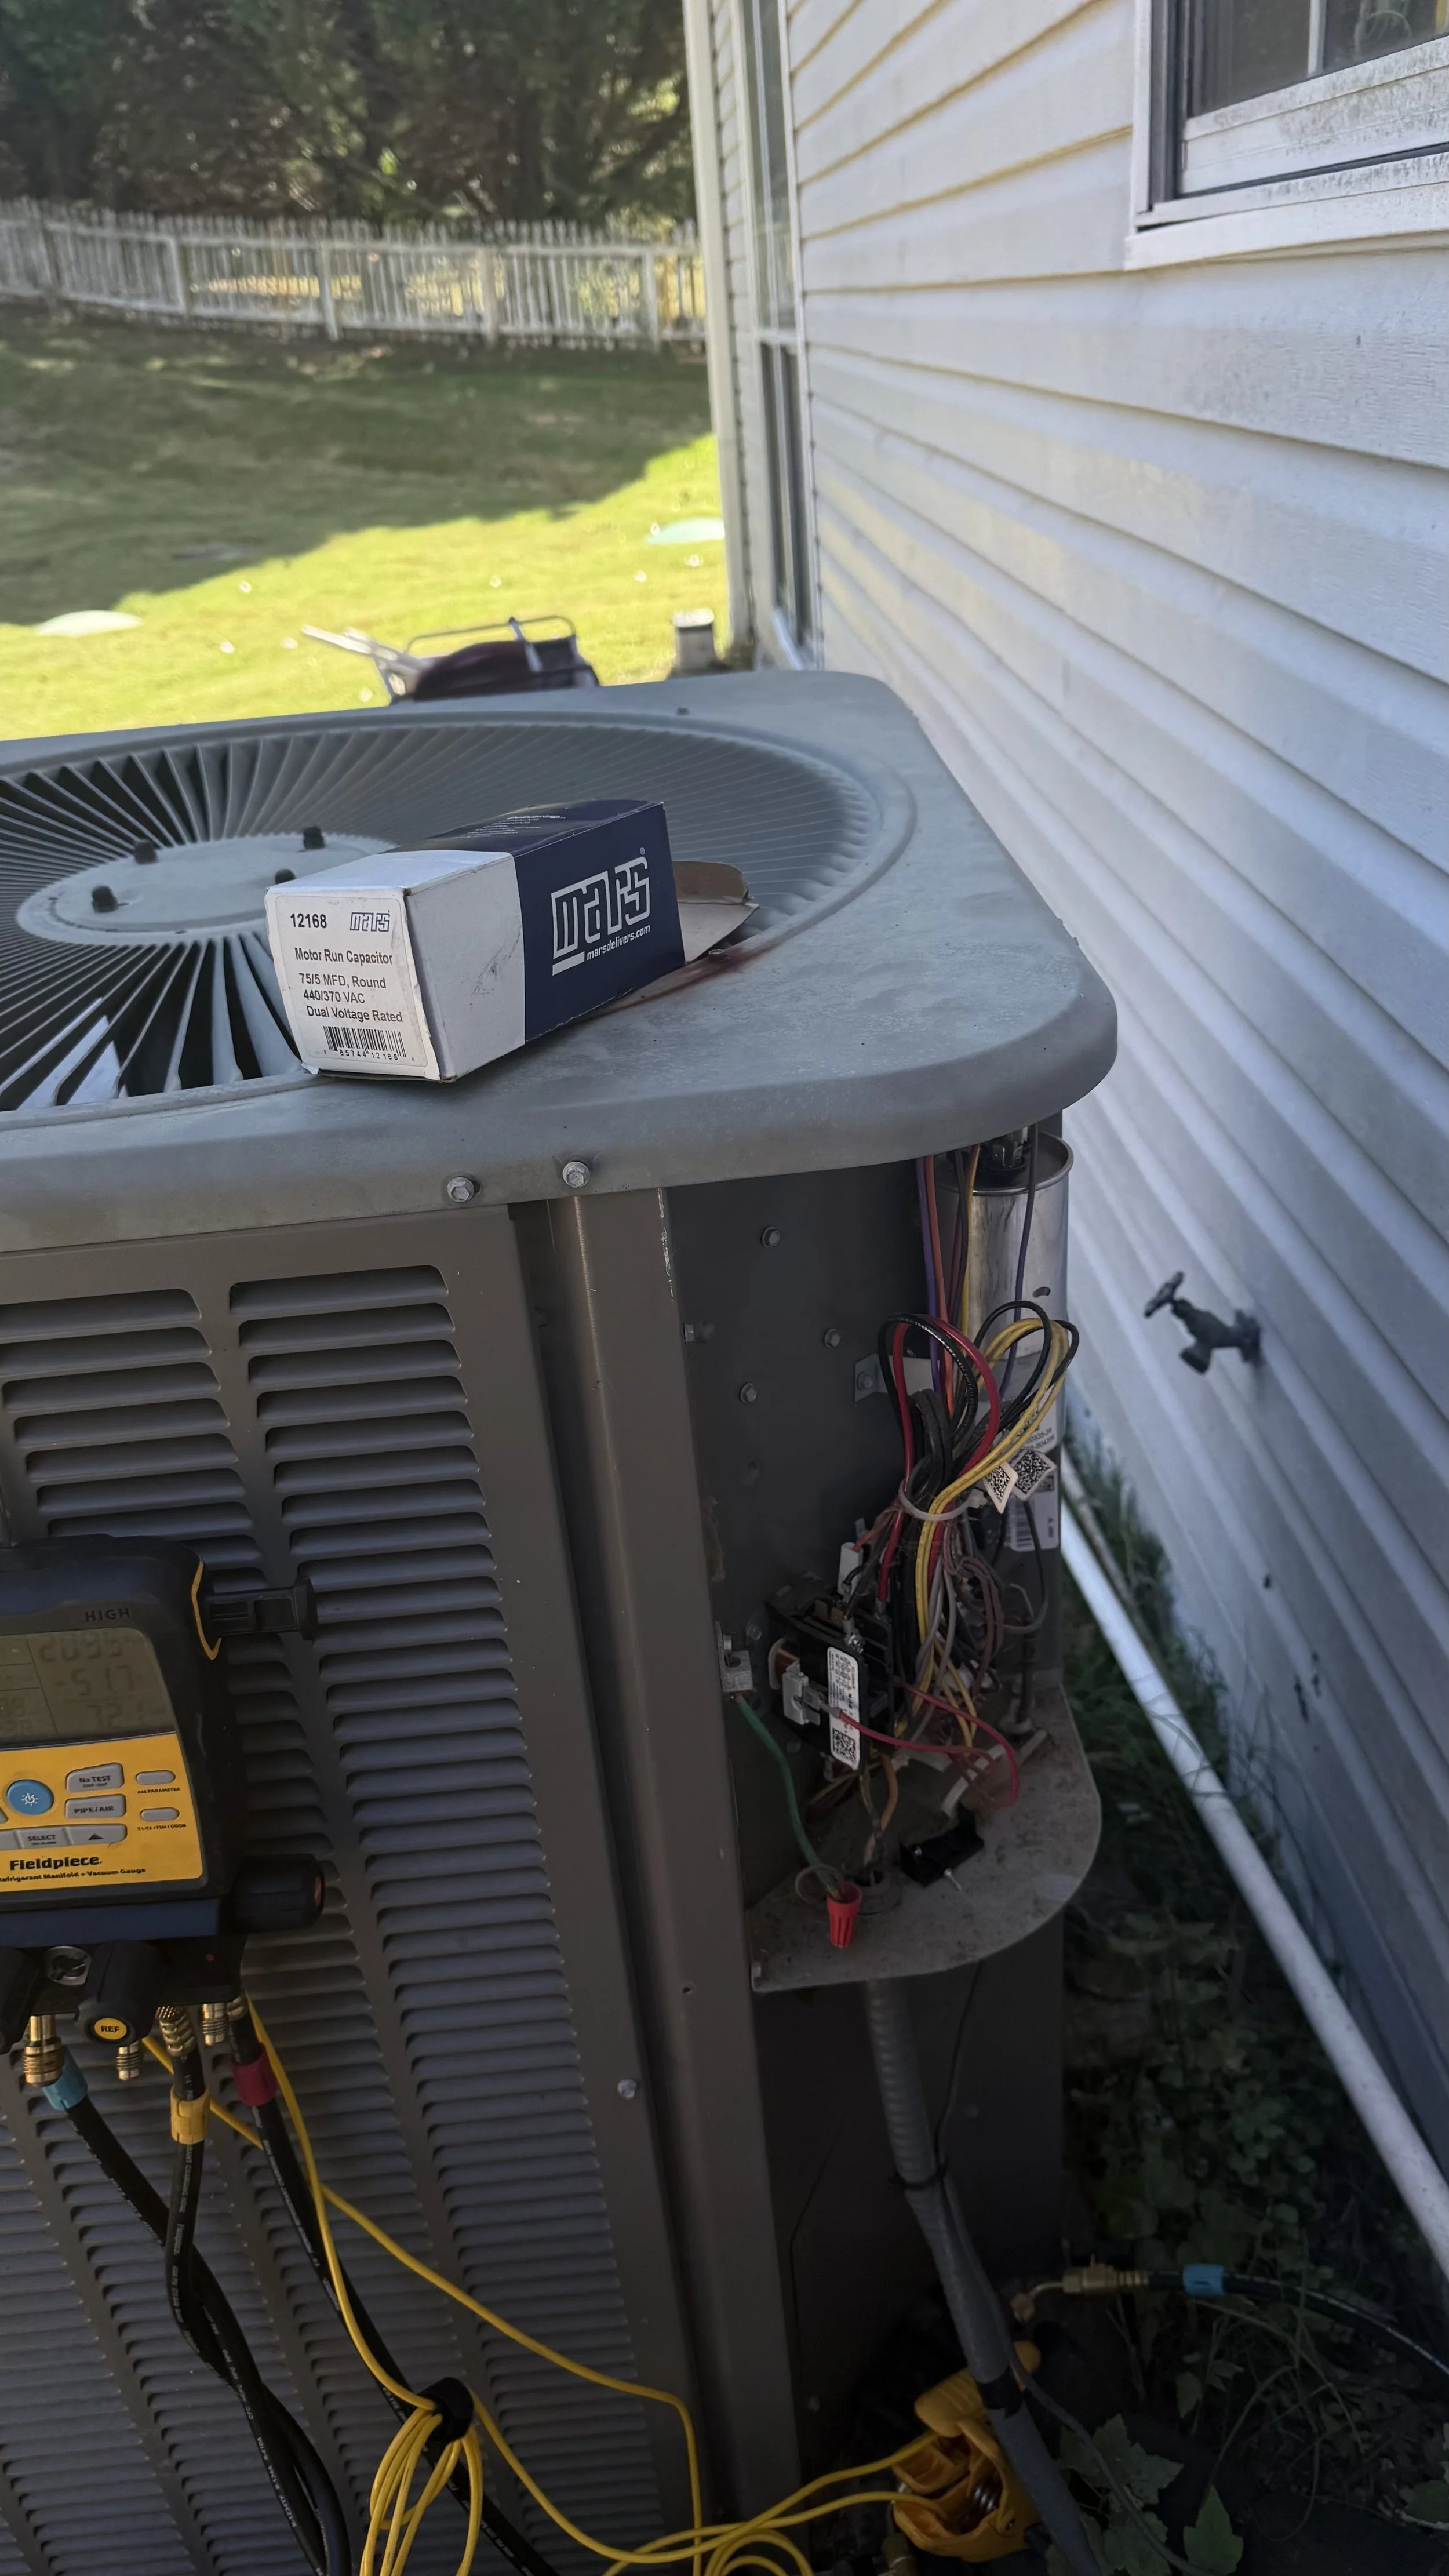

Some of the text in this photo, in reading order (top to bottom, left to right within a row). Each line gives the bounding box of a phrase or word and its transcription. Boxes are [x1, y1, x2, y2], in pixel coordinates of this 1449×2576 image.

[290, 913, 327, 928] 12168
[587, 925, 650, 960] marsdelivers.com
[294, 948, 392, 966] Motor Run Capacitor
[299, 973, 387, 989] 75/5 MFD, Round
[304, 989, 365, 1003] 440/370 VAC
[307, 1006, 403, 1023] Dual Voltage Rated
[85, 1607, 130, 1622] HIGH
